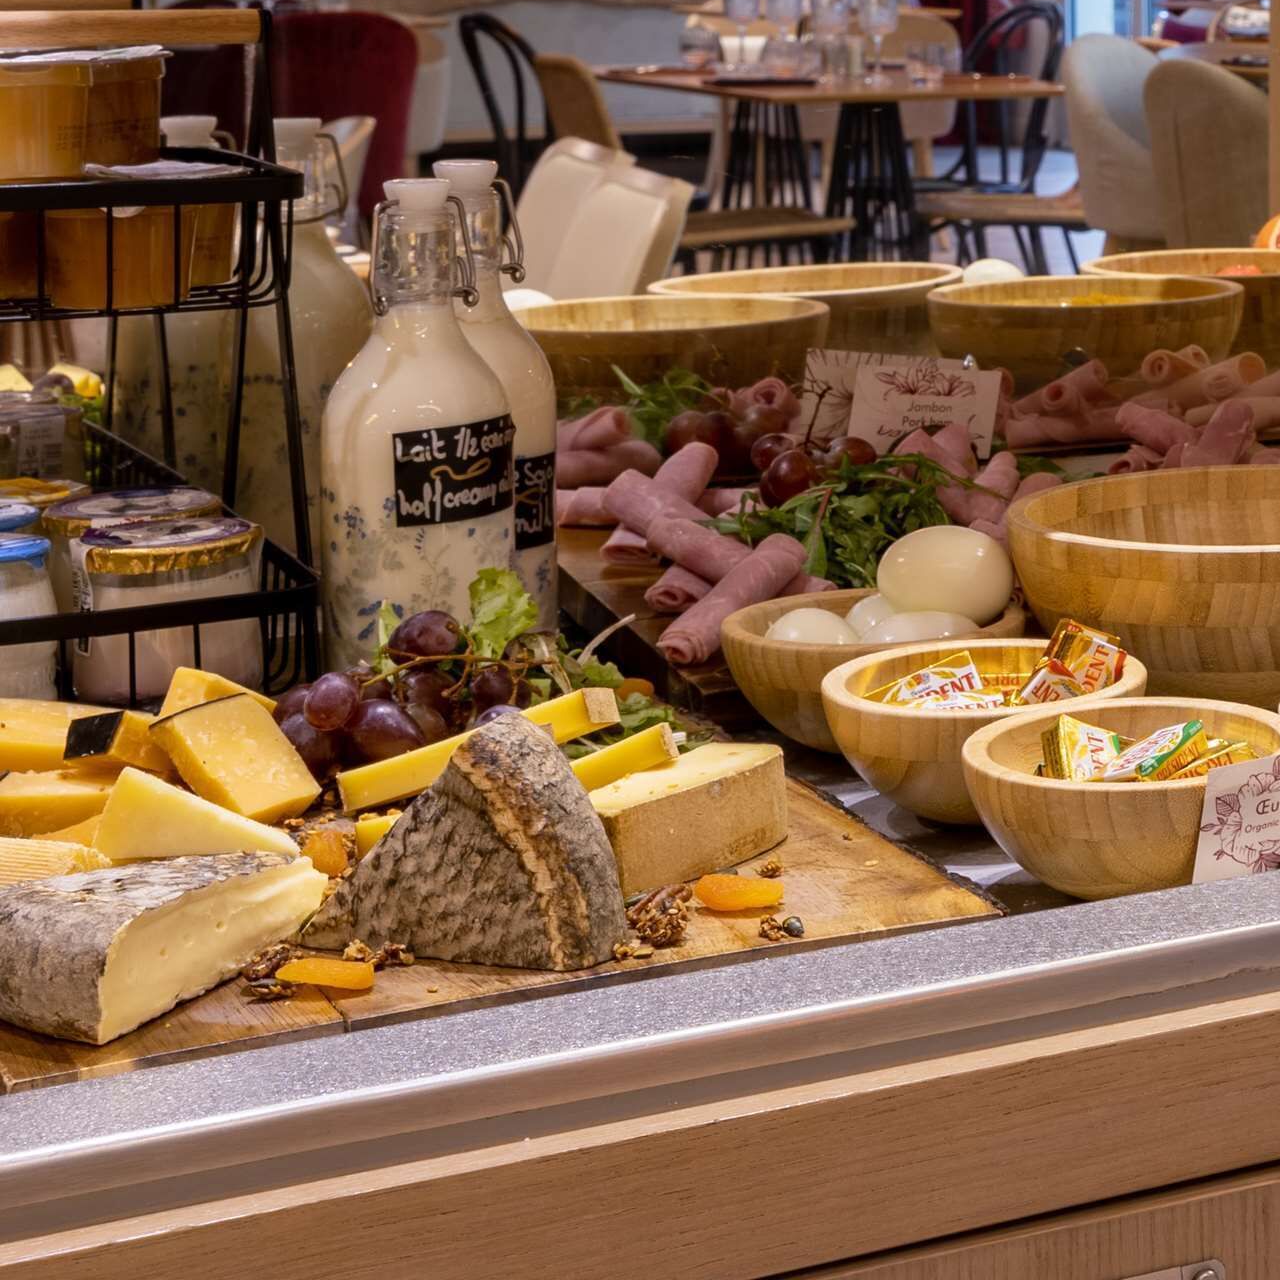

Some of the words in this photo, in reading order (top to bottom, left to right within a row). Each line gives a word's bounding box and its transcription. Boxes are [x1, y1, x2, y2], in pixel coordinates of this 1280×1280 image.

[908, 402, 953, 413] Jambon
[902, 416, 926, 427] Pork
[395, 429, 447, 463] Lait
[1244, 818, 1280, 834] Organic
